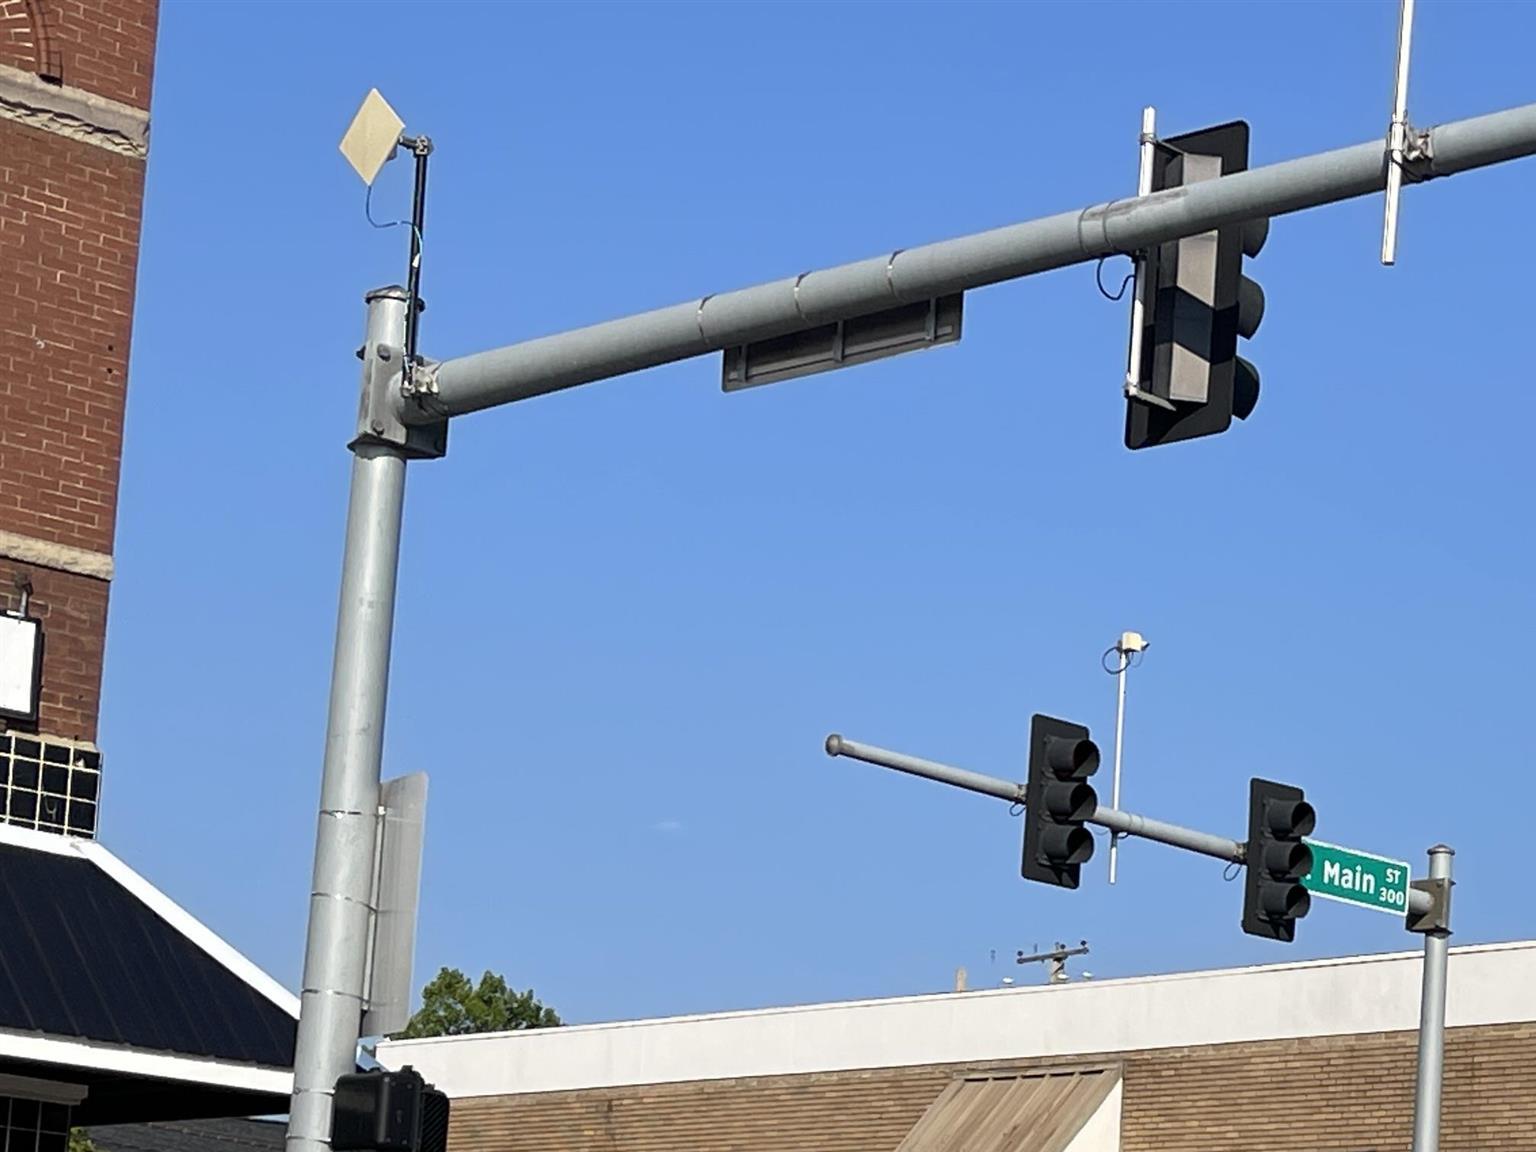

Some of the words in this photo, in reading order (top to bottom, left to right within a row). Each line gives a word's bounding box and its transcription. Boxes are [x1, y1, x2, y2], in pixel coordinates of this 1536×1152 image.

[1323, 860, 1375, 894] Main
[1386, 868, 1401, 884] ST
[1379, 887, 1405, 905] 300
